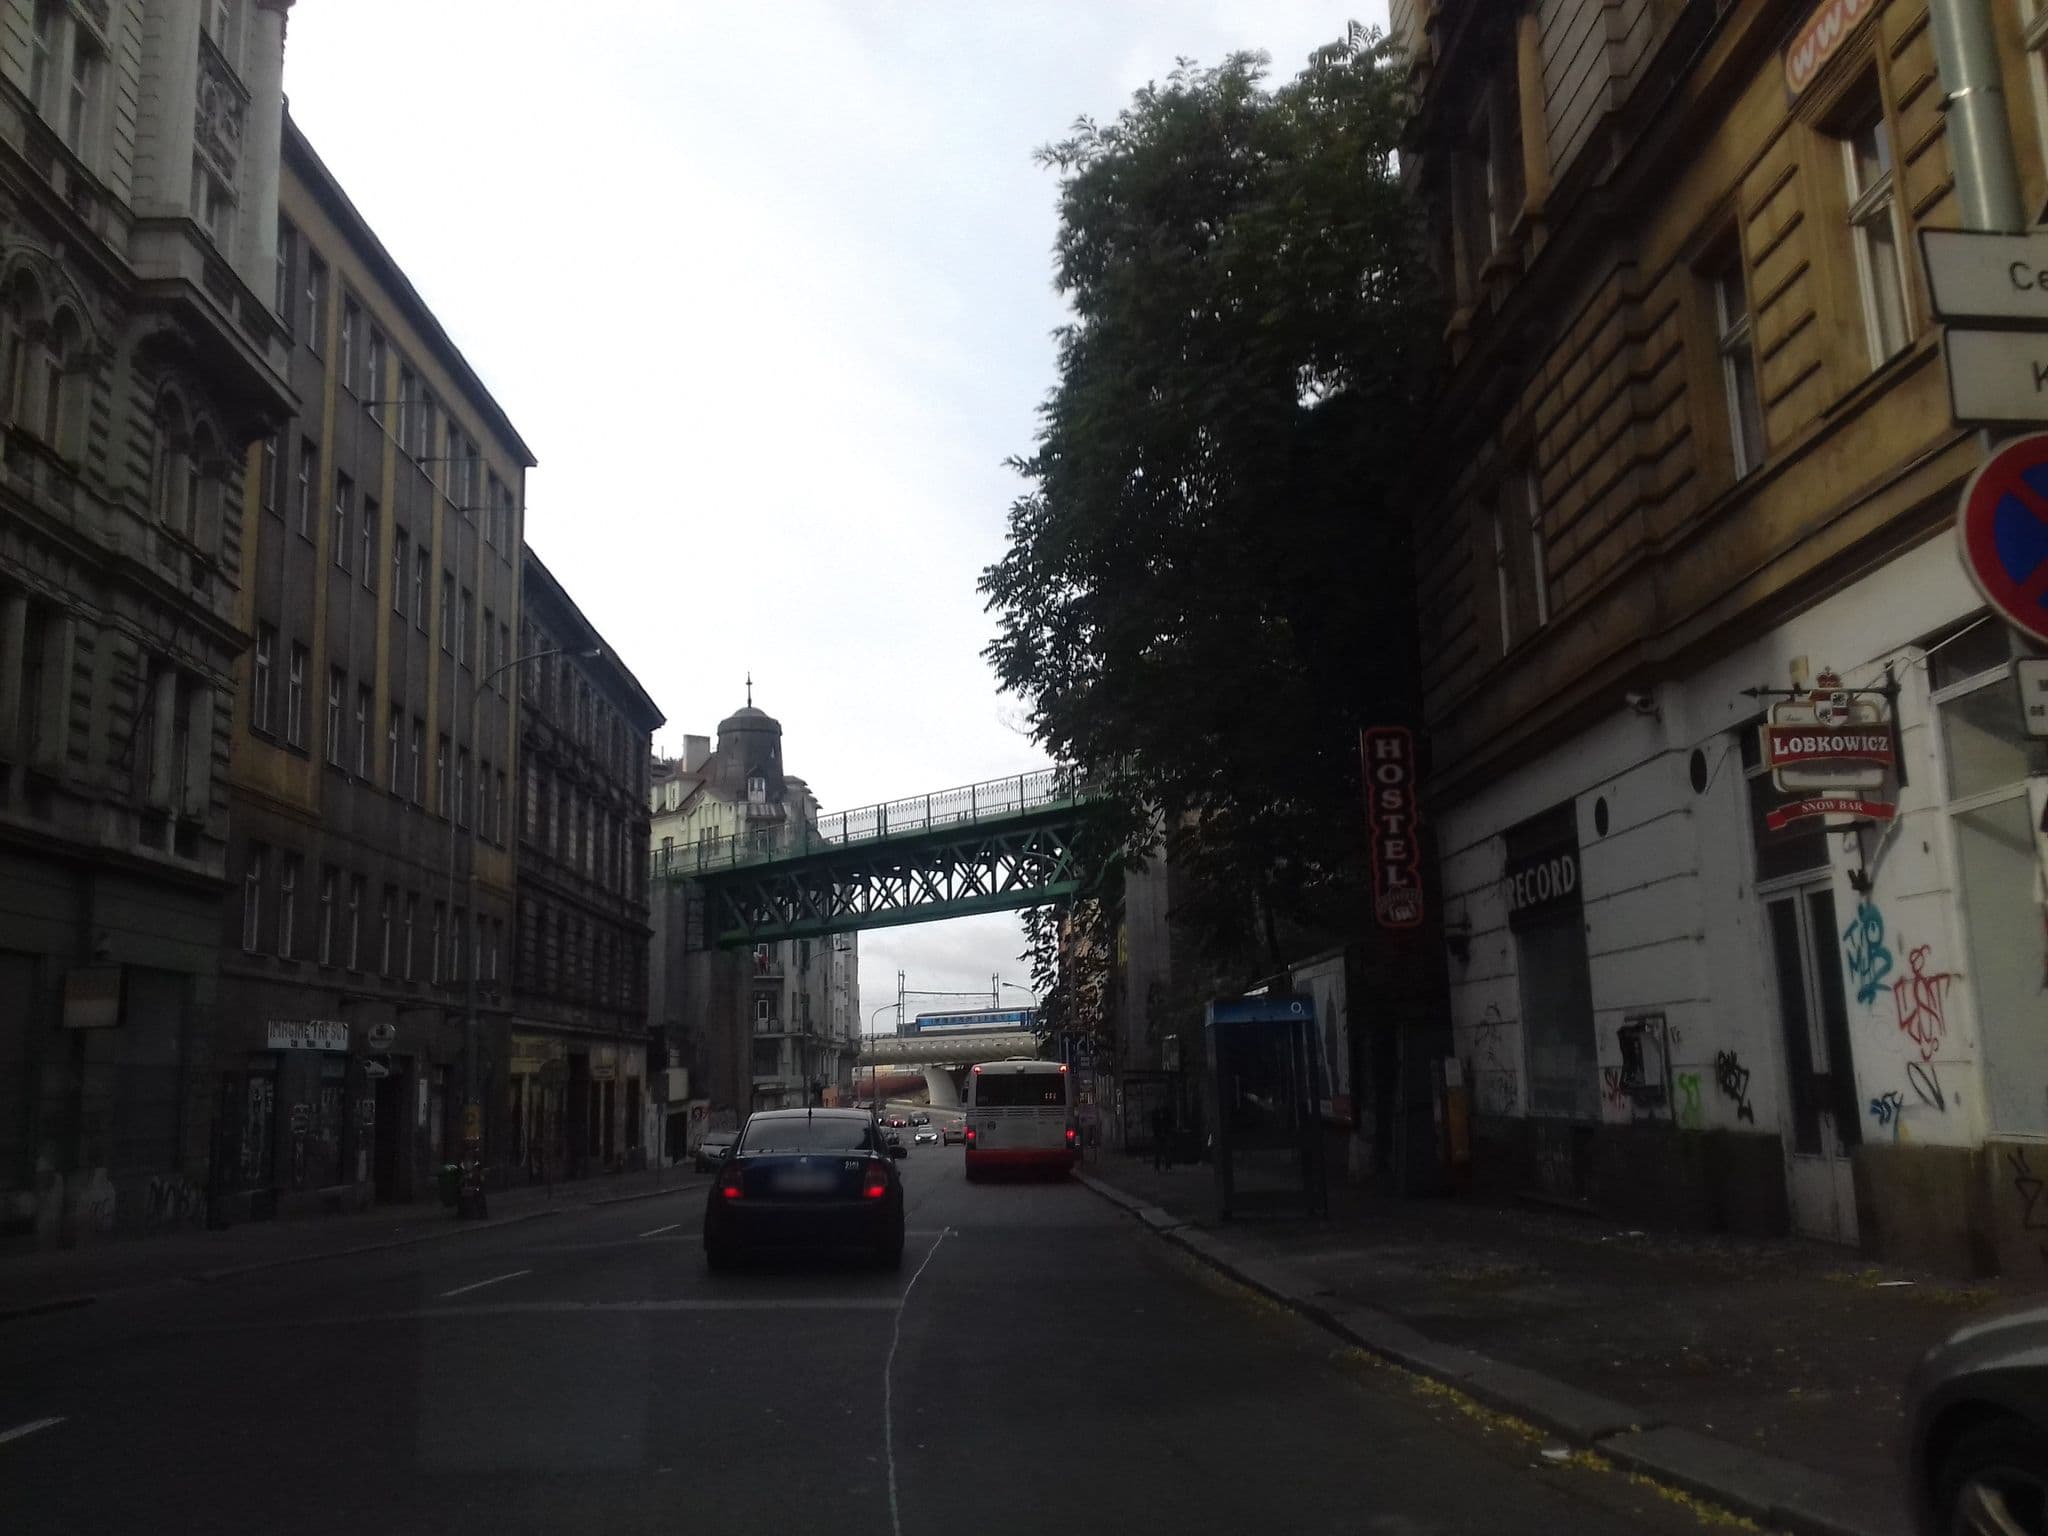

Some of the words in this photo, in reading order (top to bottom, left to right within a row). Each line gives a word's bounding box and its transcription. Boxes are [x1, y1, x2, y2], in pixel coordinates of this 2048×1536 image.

[1773, 735, 1889, 755] LOBKOWICZ
[1375, 738, 1408, 886] HOSTEL
[1801, 800, 1835, 813] SNOW
[1839, 801, 1864, 812] BAR
